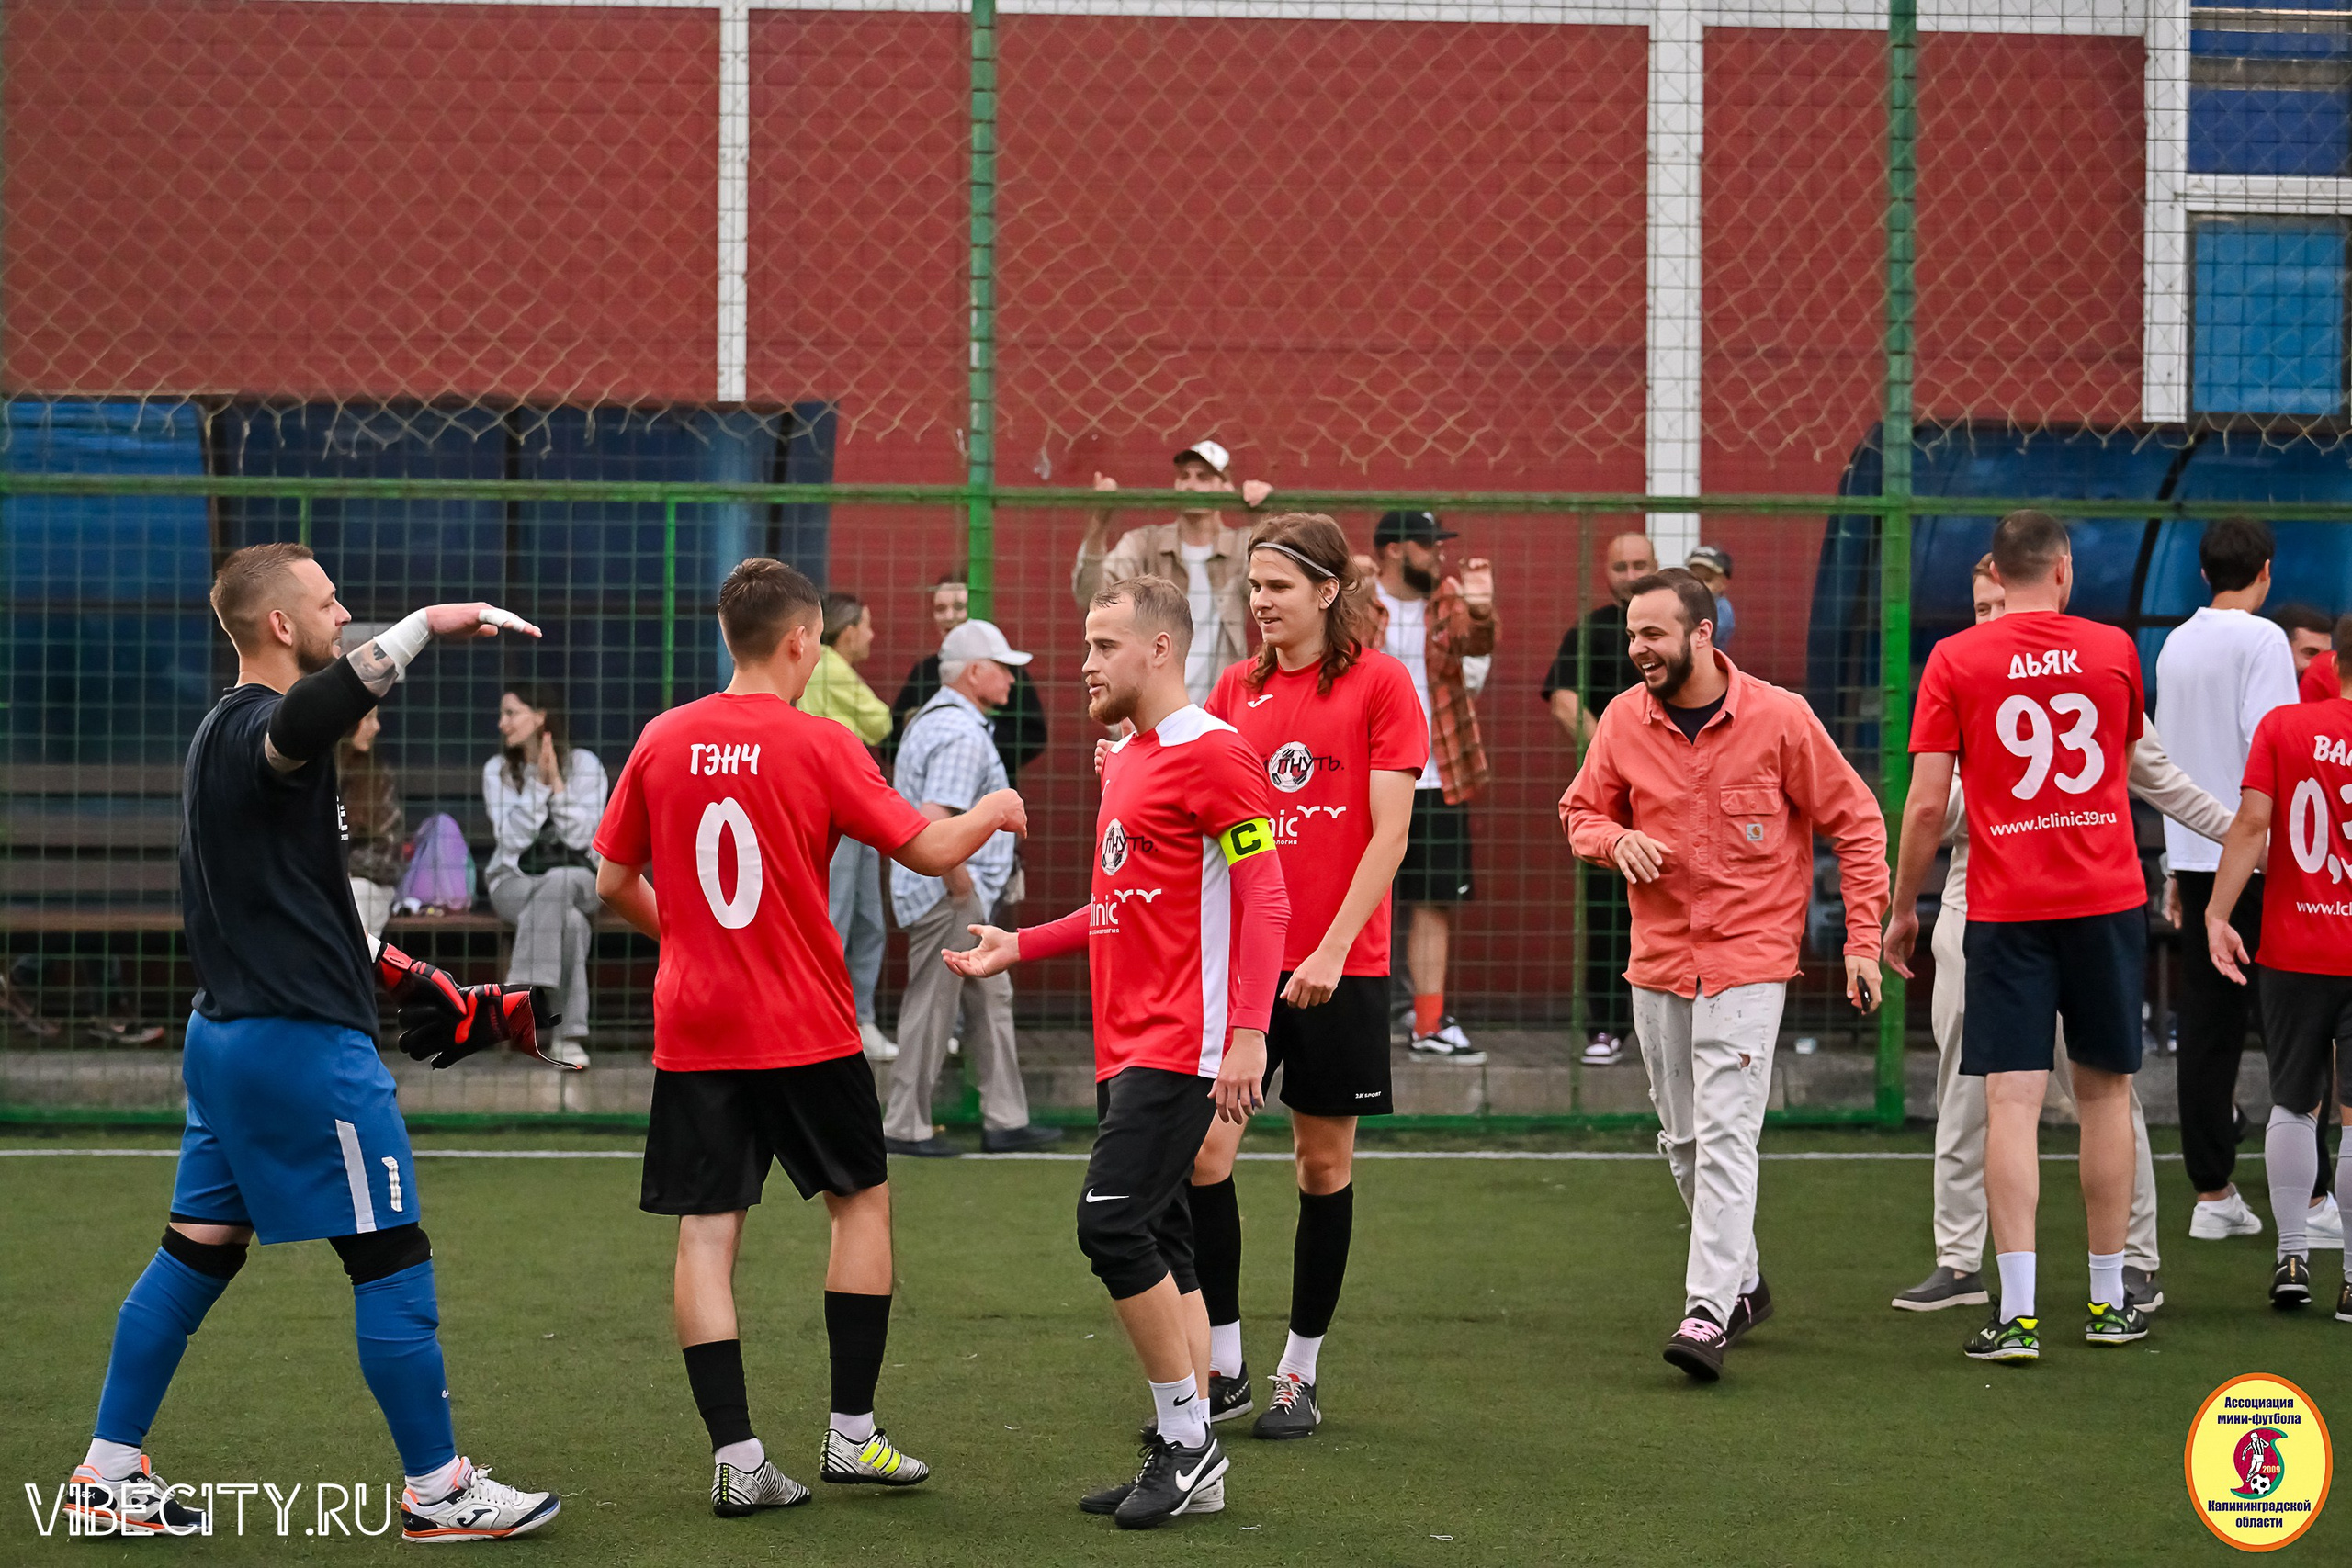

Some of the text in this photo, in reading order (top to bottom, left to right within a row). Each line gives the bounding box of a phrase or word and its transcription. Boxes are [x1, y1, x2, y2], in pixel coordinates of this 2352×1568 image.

[2007, 649, 2083, 680] ДЬЯК
[690, 743, 762, 776] ГЭНЧ
[1996, 692, 2105, 801] 93
[1230, 822, 1261, 856] C
[1989, 810, 2118, 837] www.lclinic39.ru
[695, 796, 763, 930] 0
[381, 1156, 403, 1213] 1
